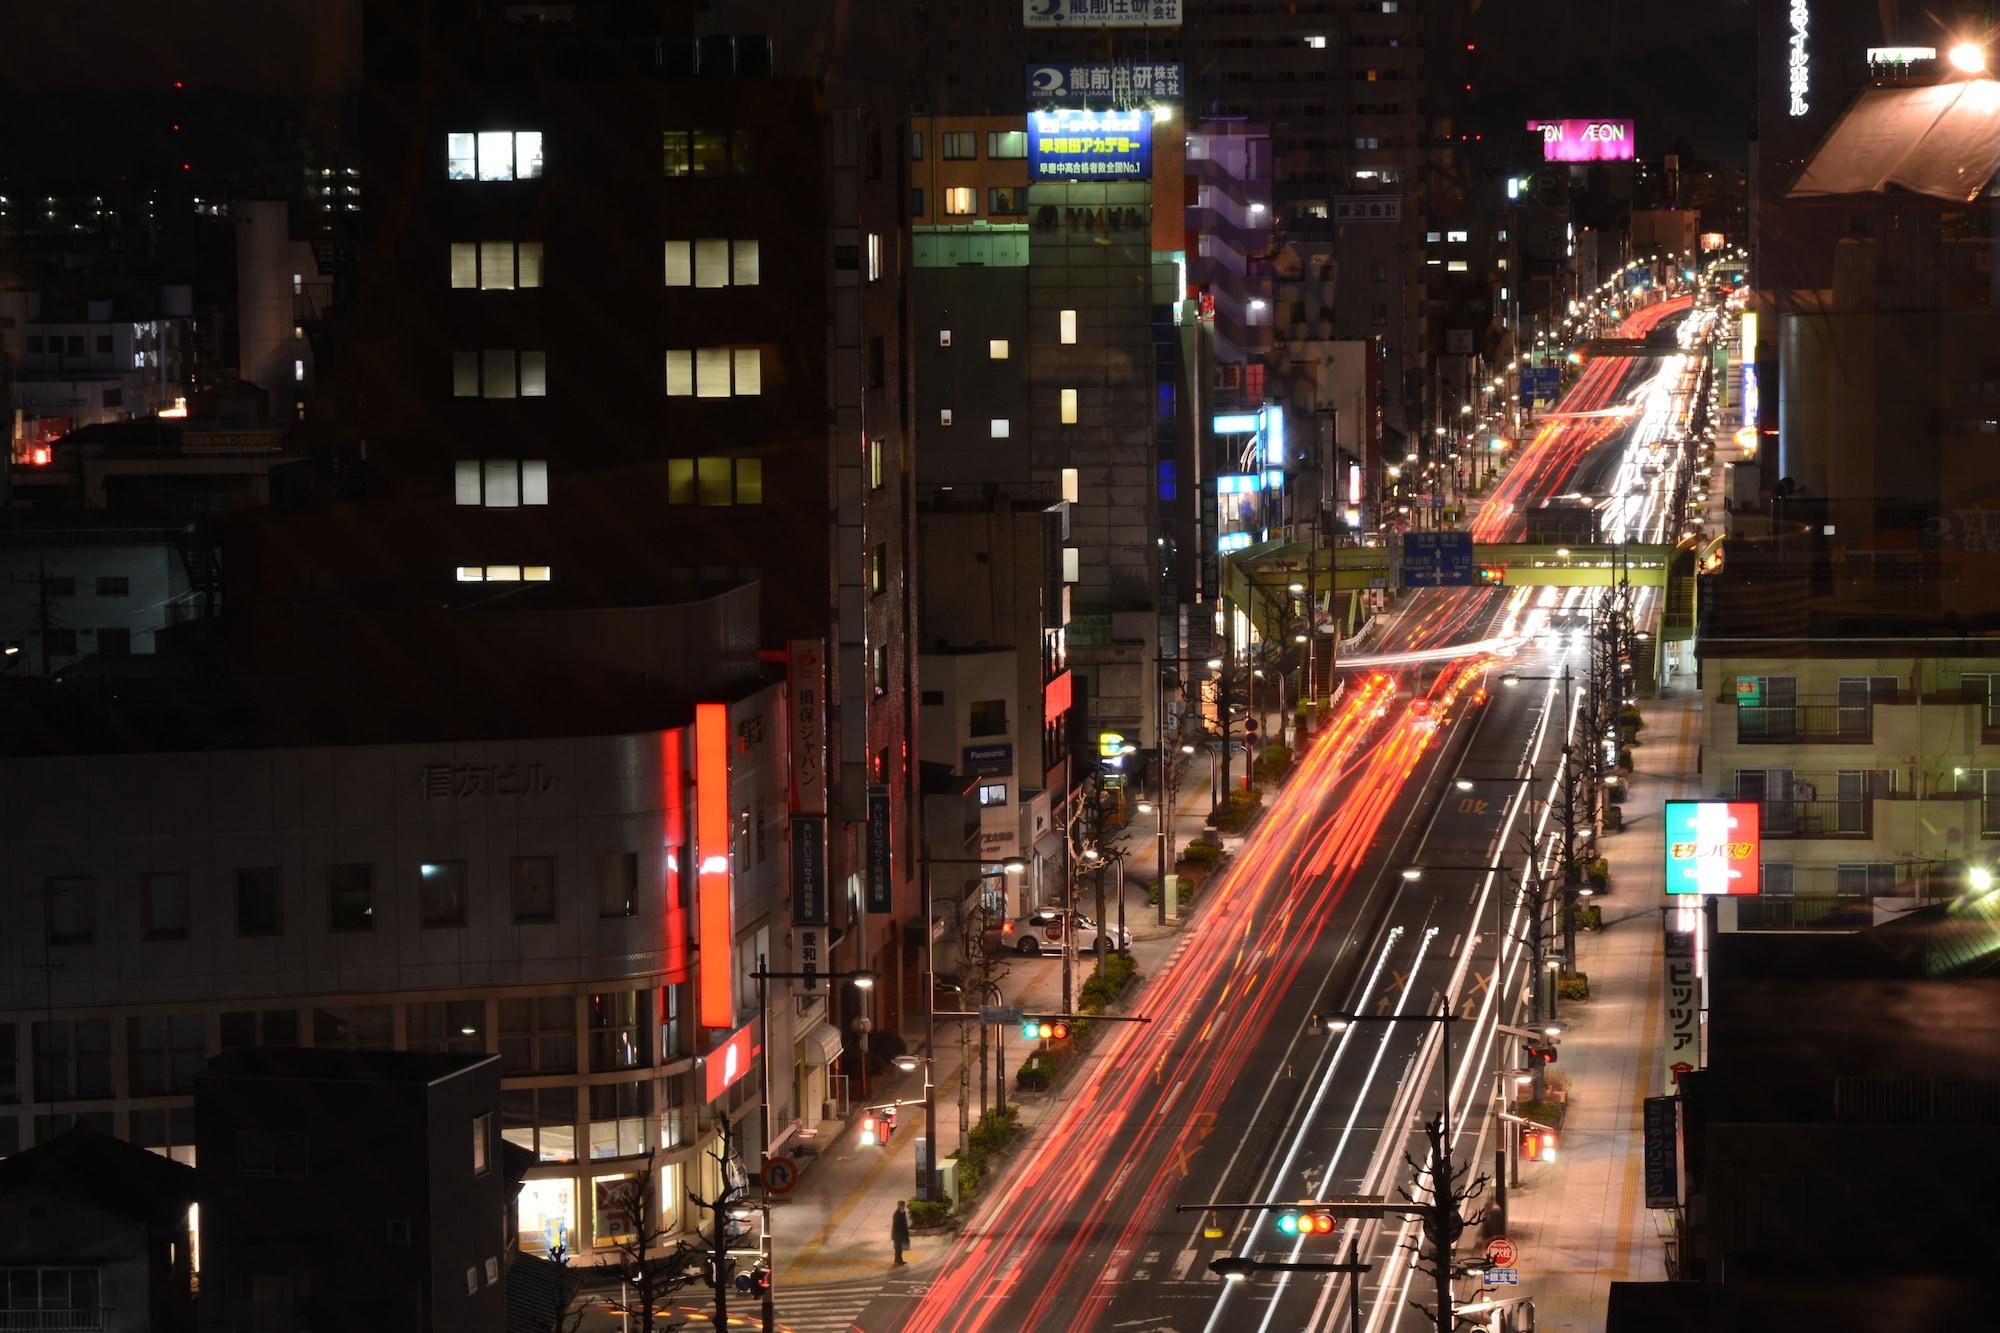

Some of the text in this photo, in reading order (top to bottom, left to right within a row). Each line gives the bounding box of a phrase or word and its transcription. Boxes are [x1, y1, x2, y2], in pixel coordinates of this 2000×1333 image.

[1070, 67, 1152, 90] 龍前住研
[799, 689, 816, 786] 損保ジャパン
[970, 749, 1006, 760] Panasonic
[418, 762, 554, 801] 信友ビル
